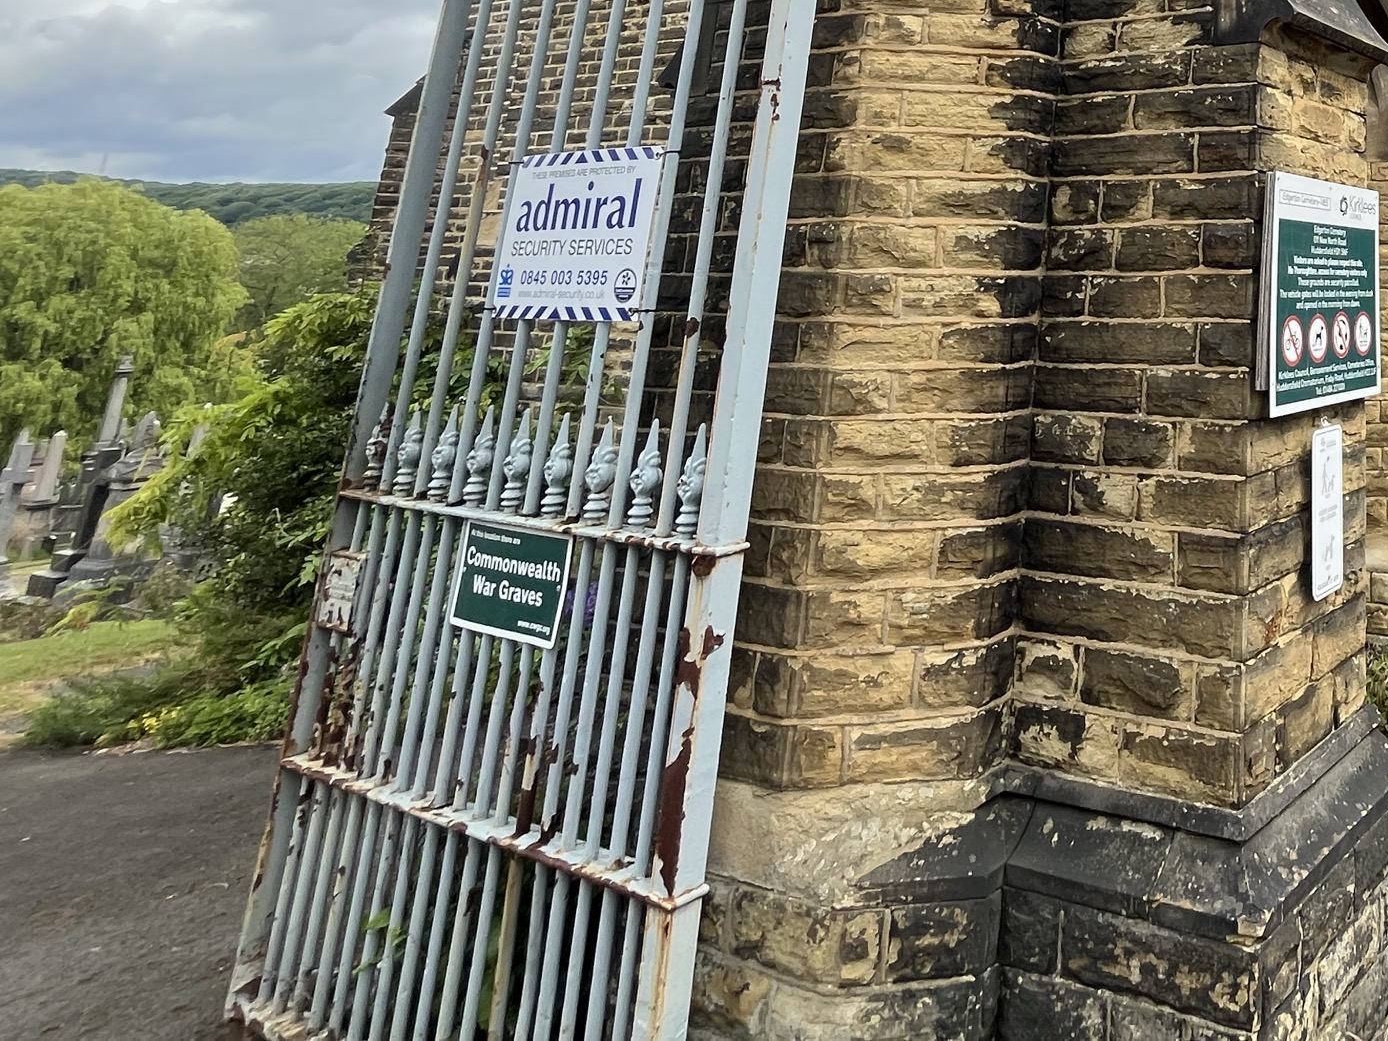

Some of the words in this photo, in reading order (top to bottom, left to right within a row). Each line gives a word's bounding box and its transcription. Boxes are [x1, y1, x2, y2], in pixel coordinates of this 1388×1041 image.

[532, 170, 549, 180] THESE
[549, 168, 575, 179] PREMISES
[576, 167, 588, 177] ARE
[589, 165, 625, 176] PROTECTED
[626, 164, 637, 174] BY
[516, 178, 643, 232] admiral
[1349, 194, 1376, 215] Kirklees
[511, 240, 566, 256] SECURITY
[568, 238, 633, 255] SERVICES
[520, 270, 547, 285] 0845
[551, 270, 572, 285] 003
[576, 270, 608, 285] 5395
[517, 289, 605, 301] www.admiral-security.co.uk
[467, 545, 561, 582] Commonwealth
[473, 574, 497, 597] War
[498, 580, 543, 607] Graves
